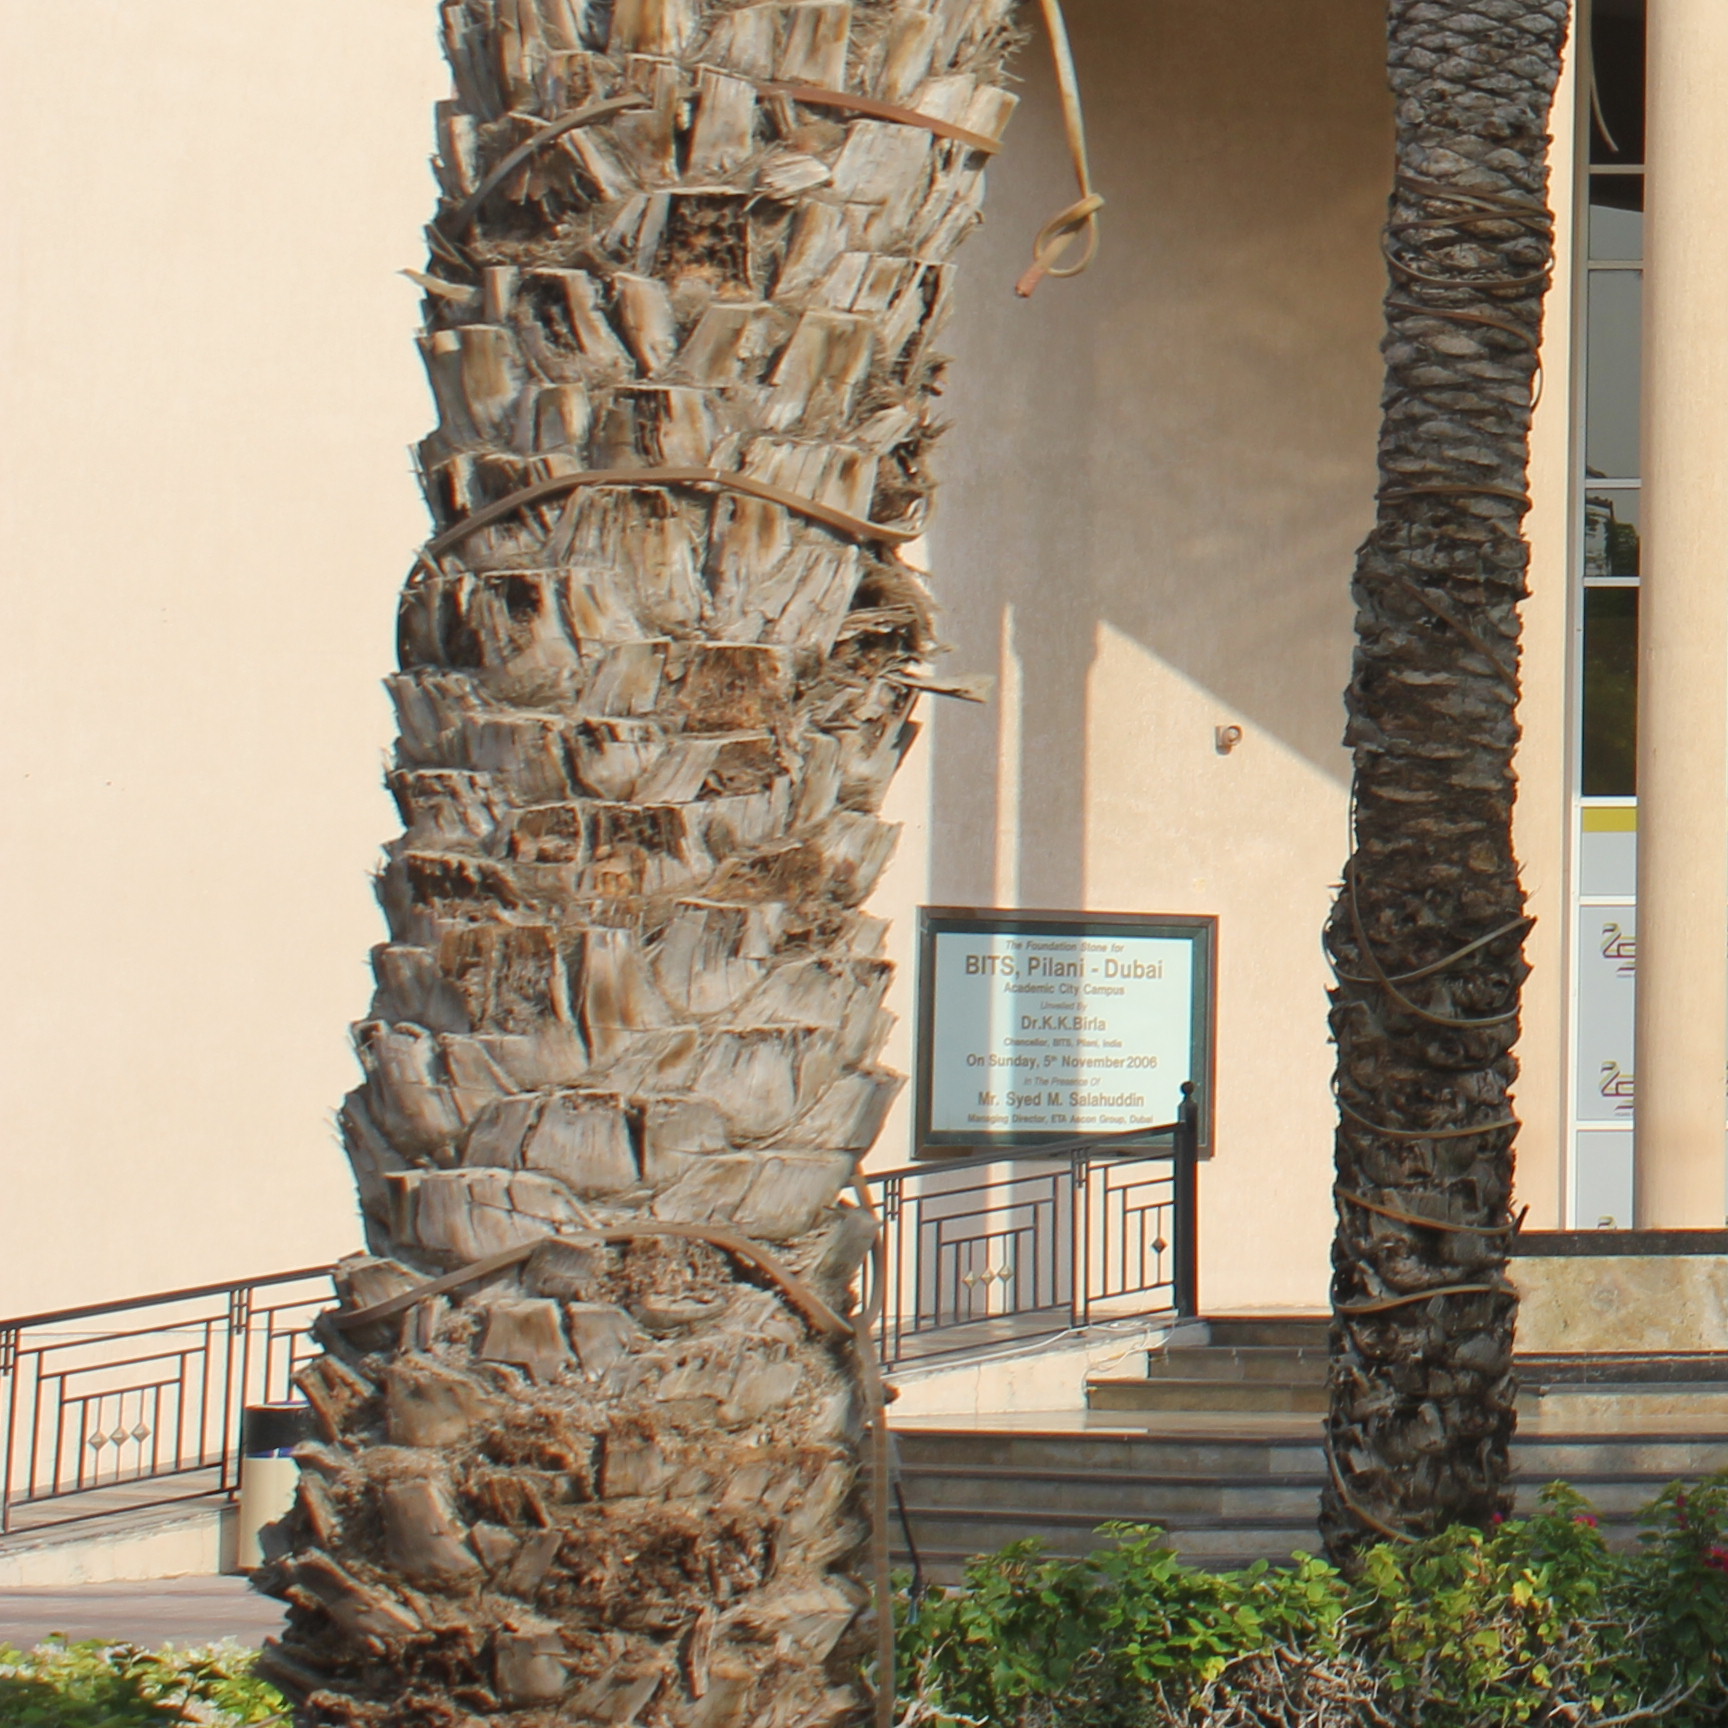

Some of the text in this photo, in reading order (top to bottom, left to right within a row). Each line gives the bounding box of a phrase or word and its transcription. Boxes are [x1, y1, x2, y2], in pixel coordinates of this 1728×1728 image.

[966, 954, 1020, 979] BITS,
[1028, 956, 1084, 978] Pilani
[1105, 958, 1163, 979] Dubai
[966, 1053, 985, 1067] On
[1062, 1055, 1125, 1068] November
[1006, 1091, 1042, 1109] Syed
[1069, 1091, 1144, 1107] Salahuddin
